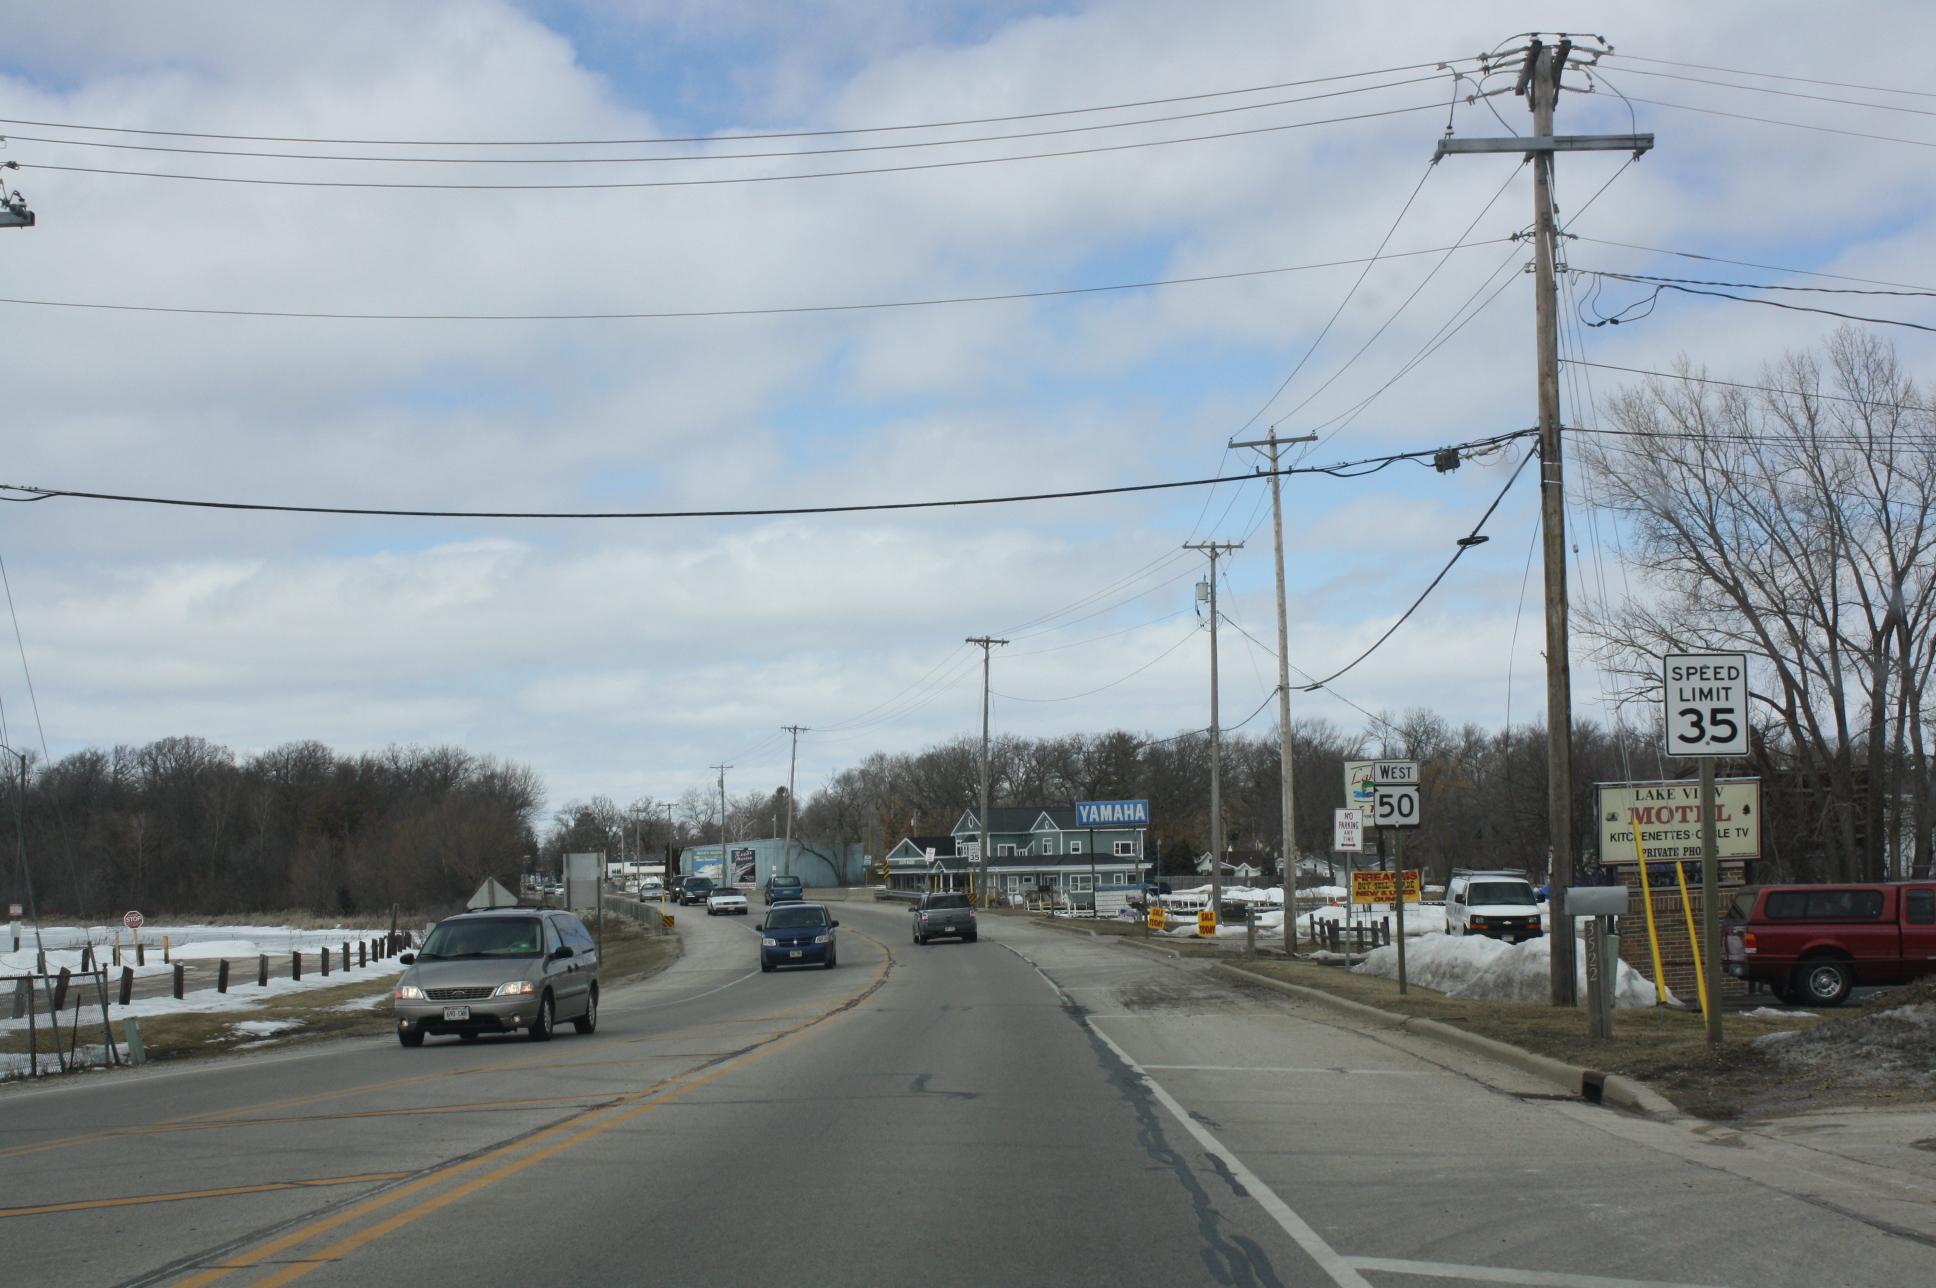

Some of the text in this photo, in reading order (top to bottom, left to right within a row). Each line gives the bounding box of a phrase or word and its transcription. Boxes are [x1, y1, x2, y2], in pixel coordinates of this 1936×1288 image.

[1672, 666, 1739, 681] SPEED
[1679, 687, 1732, 702] LIMIT
[1678, 708, 1738, 743] 35
[1380, 765, 1412, 779] WEST
[1635, 787, 1724, 801] LAKE VIW
[1379, 793, 1414, 818] 50
[1079, 804, 1146, 822] YAMAHA
[1344, 812, 1354, 820] NO
[1338, 821, 1360, 830] PARKING
[1610, 830, 1690, 842] KITCENETTES
[1736, 828, 1749, 838] TV
[1201, 912, 1214, 922] SALE
[1200, 925, 1216, 934] TODAY
